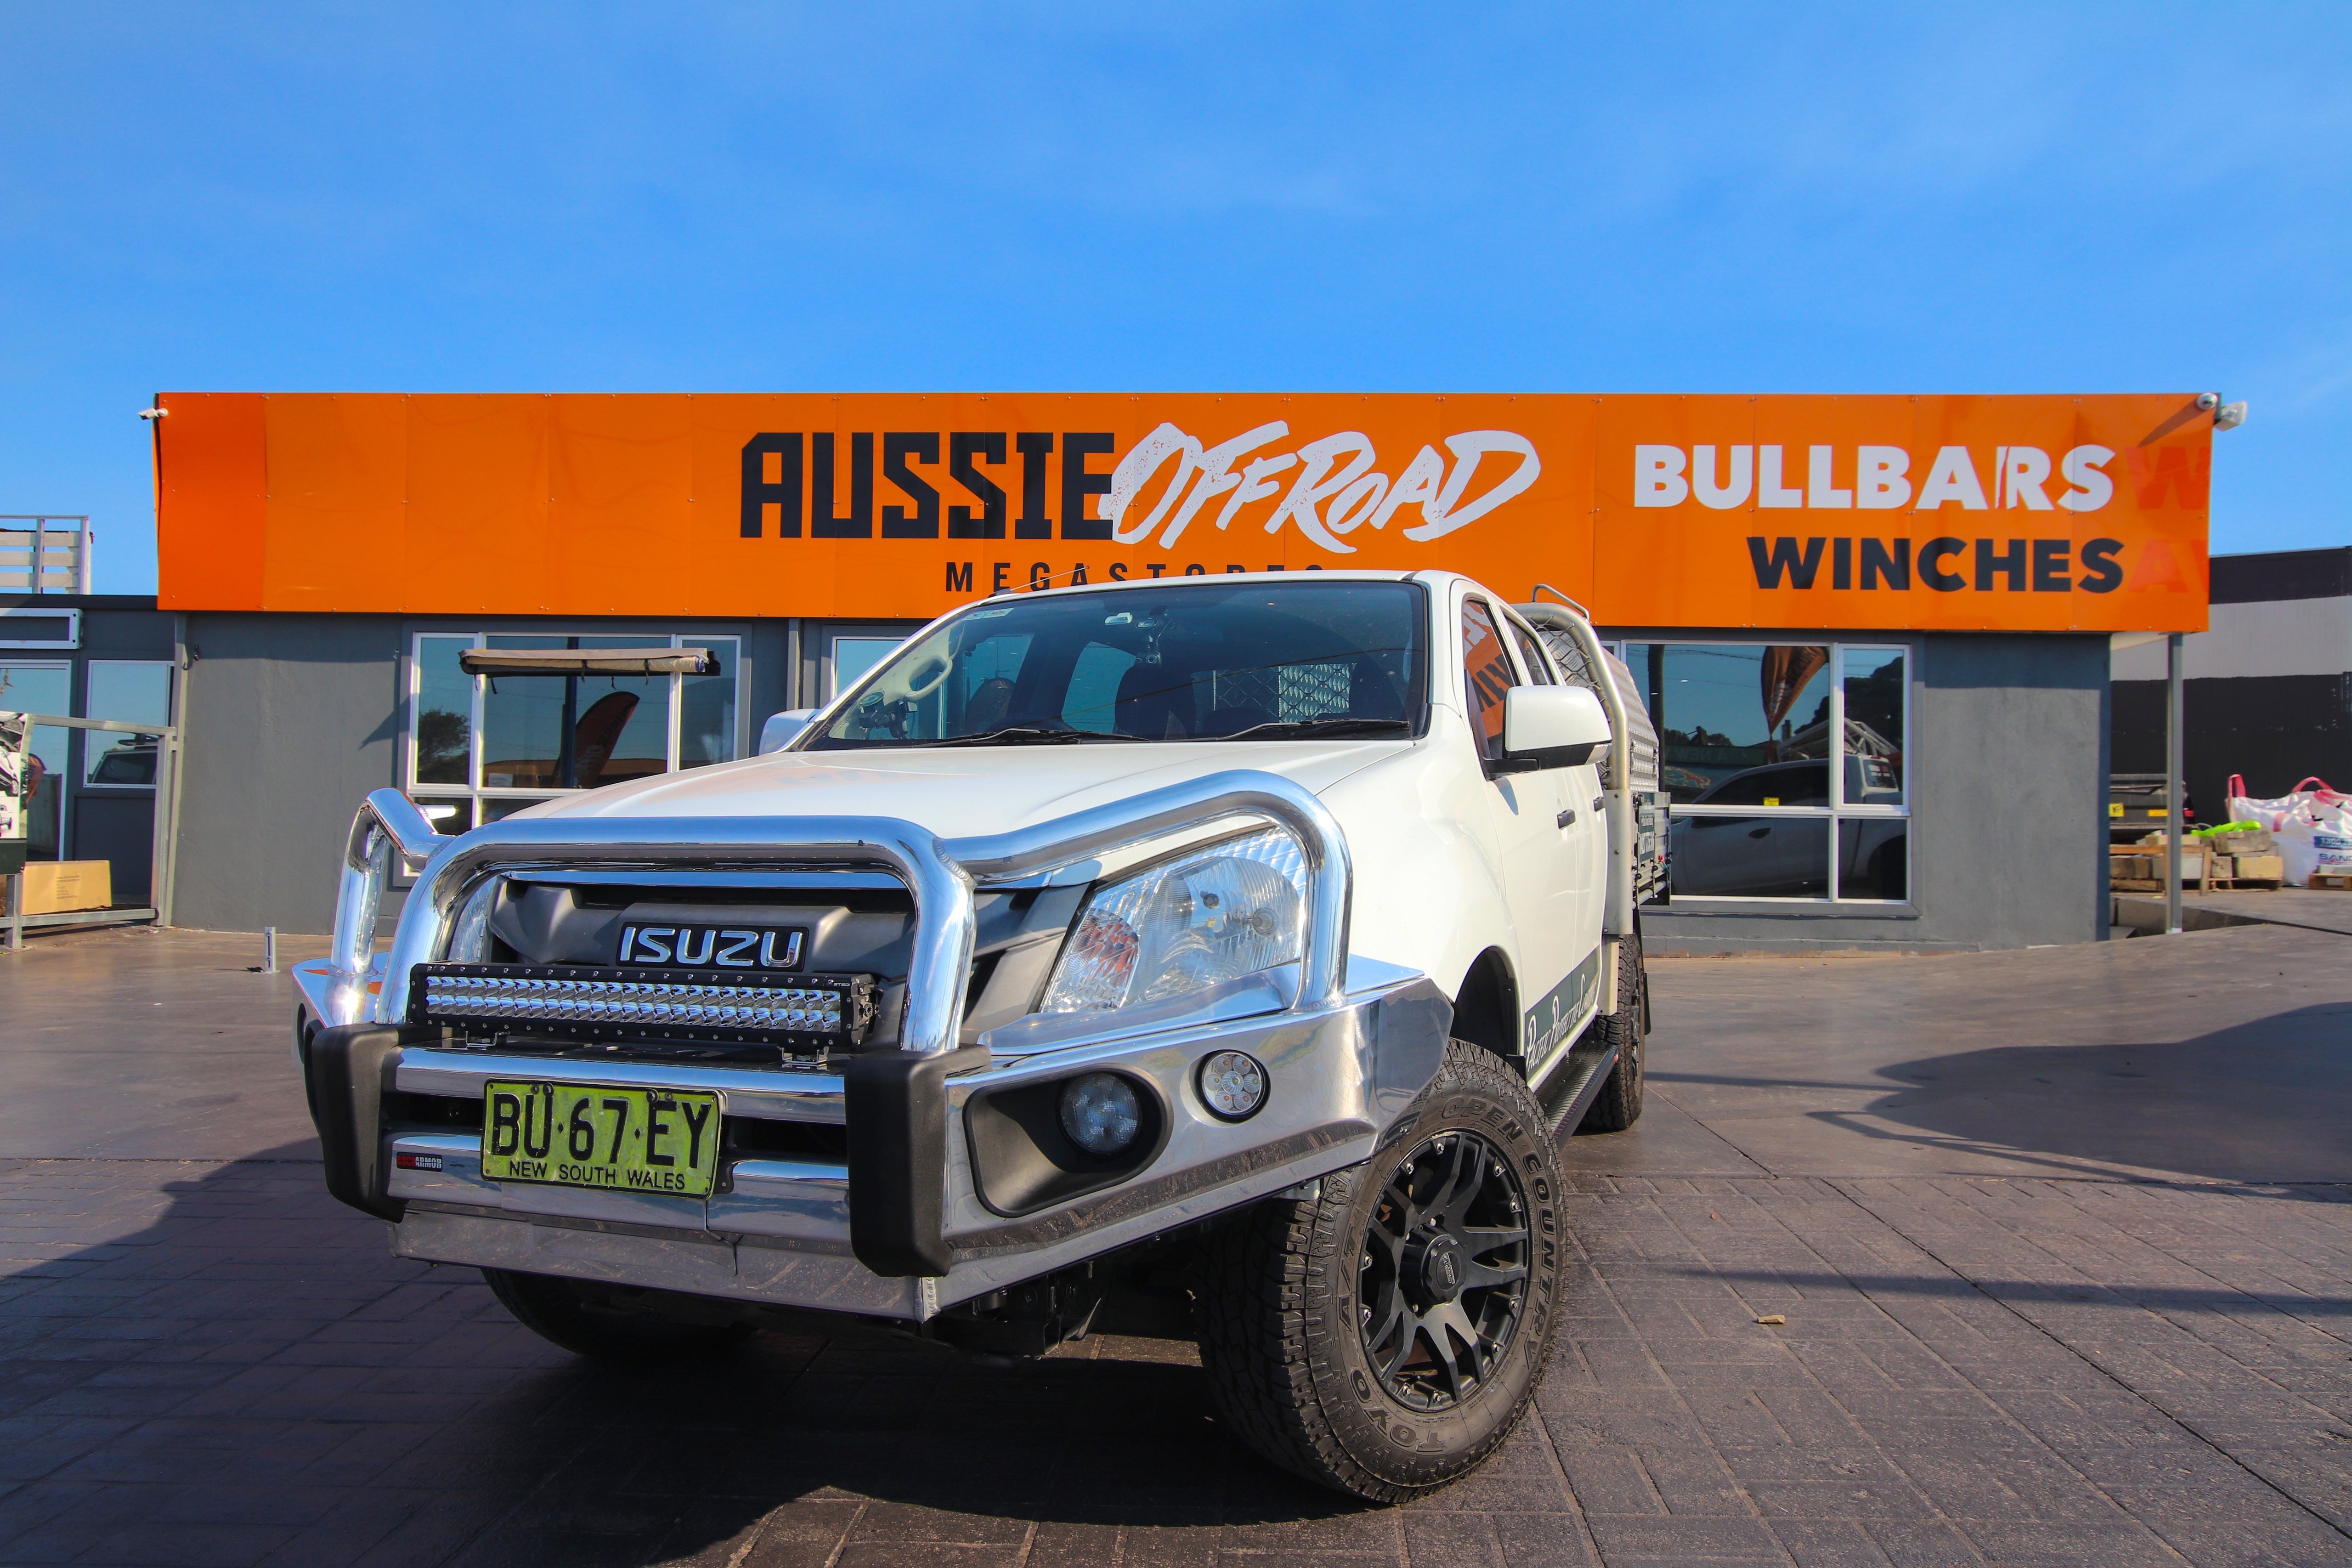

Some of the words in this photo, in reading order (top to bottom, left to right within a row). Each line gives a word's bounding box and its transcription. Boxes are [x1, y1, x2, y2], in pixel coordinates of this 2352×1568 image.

[741, 431, 1114, 539] AUSSIE
[1097, 420, 1542, 553] OFFROAD
[1634, 444, 2116, 511] BULLBARS
[945, 562, 1323, 592] MEGAST
[1747, 536, 2125, 594] WINCHES
[620, 927, 803, 968] ISUZU
[1526, 1014, 1551, 1072] PACIFIC
[1549, 995, 1580, 1052] PROTECTIVE
[1442, 1096, 1523, 1144] OPEN
[509, 1160, 548, 1177] NEW
[559, 1164, 617, 1184] SOUTH
[628, 1169, 685, 1189] WALES
[1523, 1152, 1557, 1370] COUNTRY
[1351, 1369, 1446, 1452] TOYO
